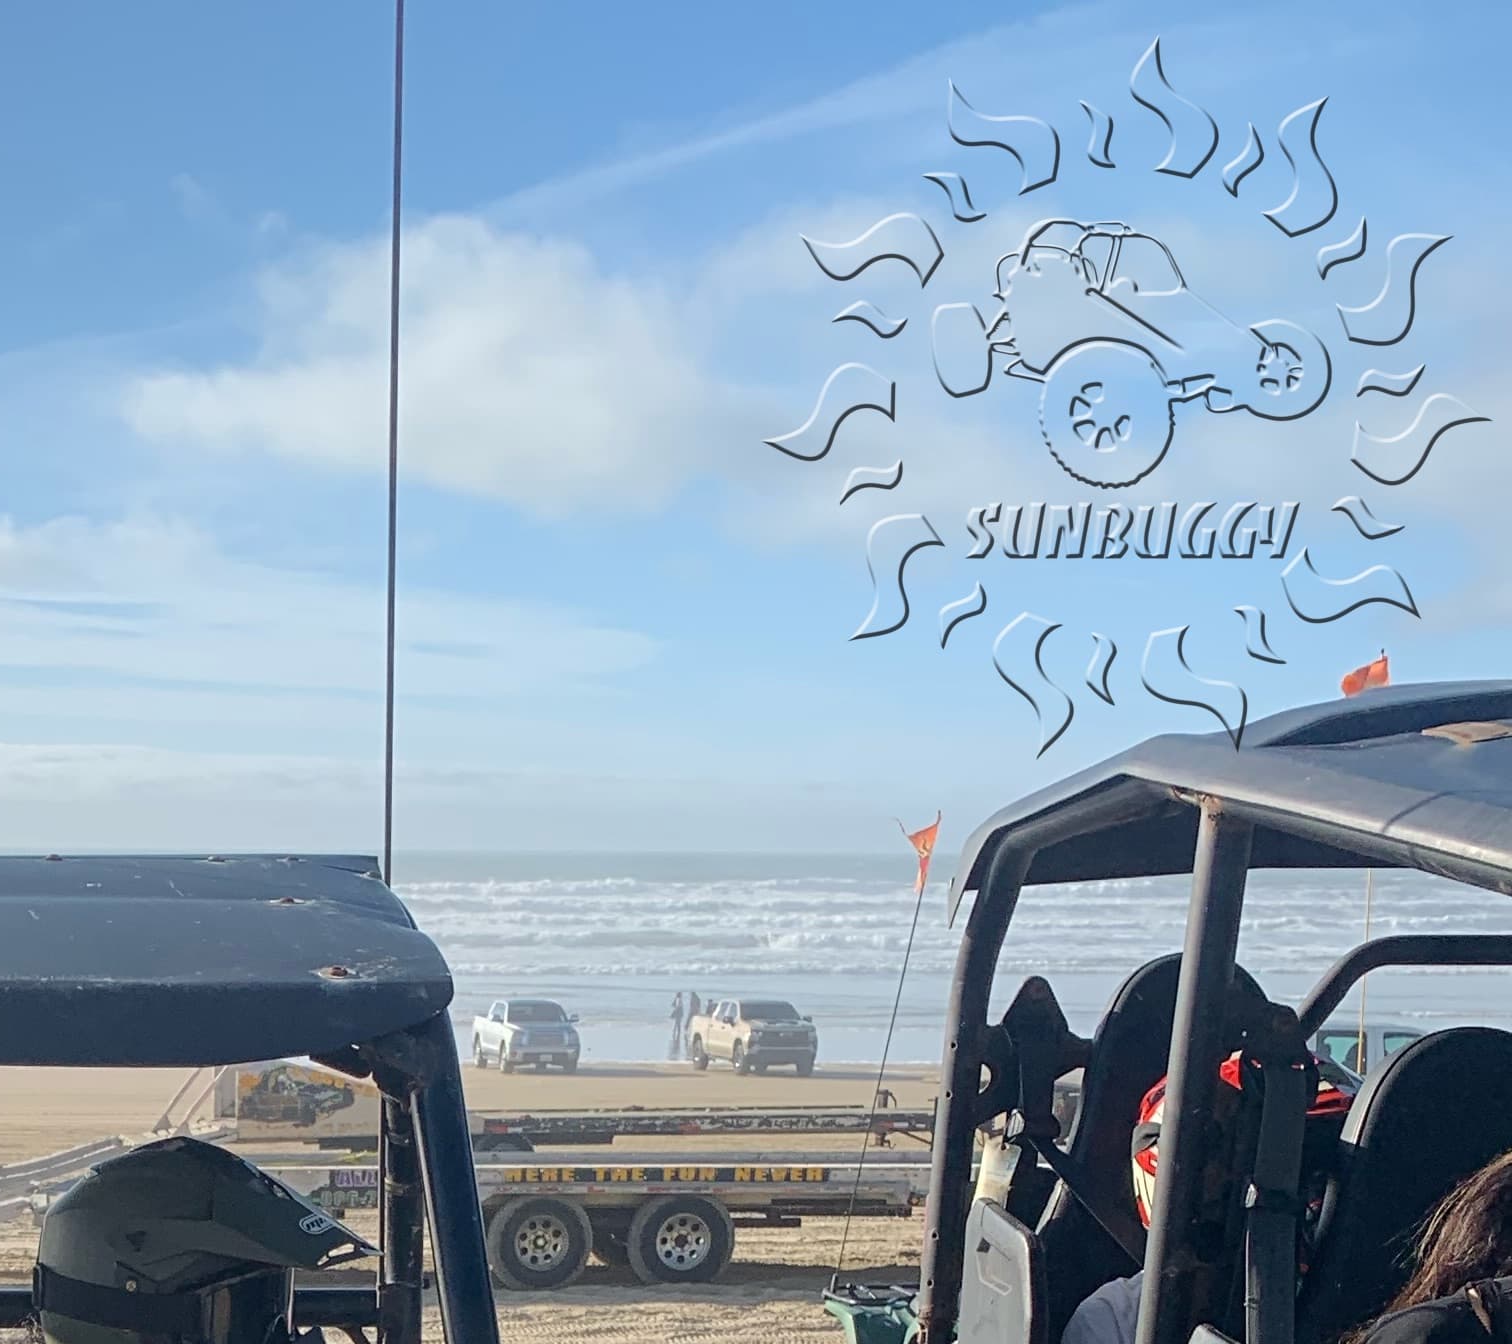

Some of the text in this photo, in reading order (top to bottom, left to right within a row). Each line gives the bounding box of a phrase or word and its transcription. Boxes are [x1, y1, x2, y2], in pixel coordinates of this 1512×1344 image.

[595, 1168, 645, 1183] THE
[663, 1168, 716, 1183] FUN
[734, 1168, 824, 1183] NEVER
